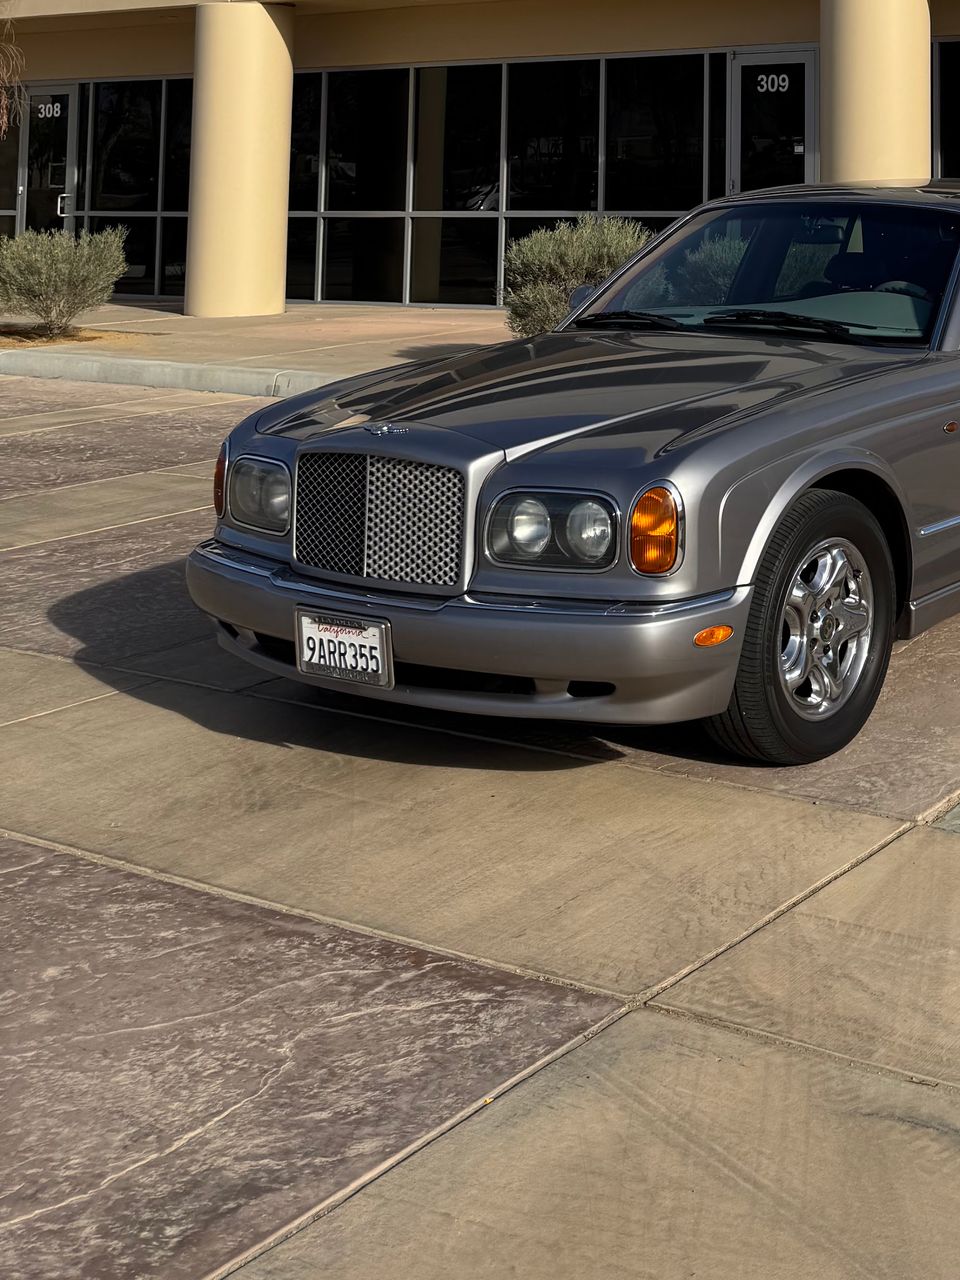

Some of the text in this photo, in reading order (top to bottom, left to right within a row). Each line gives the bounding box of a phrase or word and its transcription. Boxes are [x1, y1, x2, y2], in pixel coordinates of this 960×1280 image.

[757, 74, 789, 92] 309
[38, 103, 61, 118] 308
[318, 624, 363, 638] California
[307, 636, 380, 673] 9ARR355
